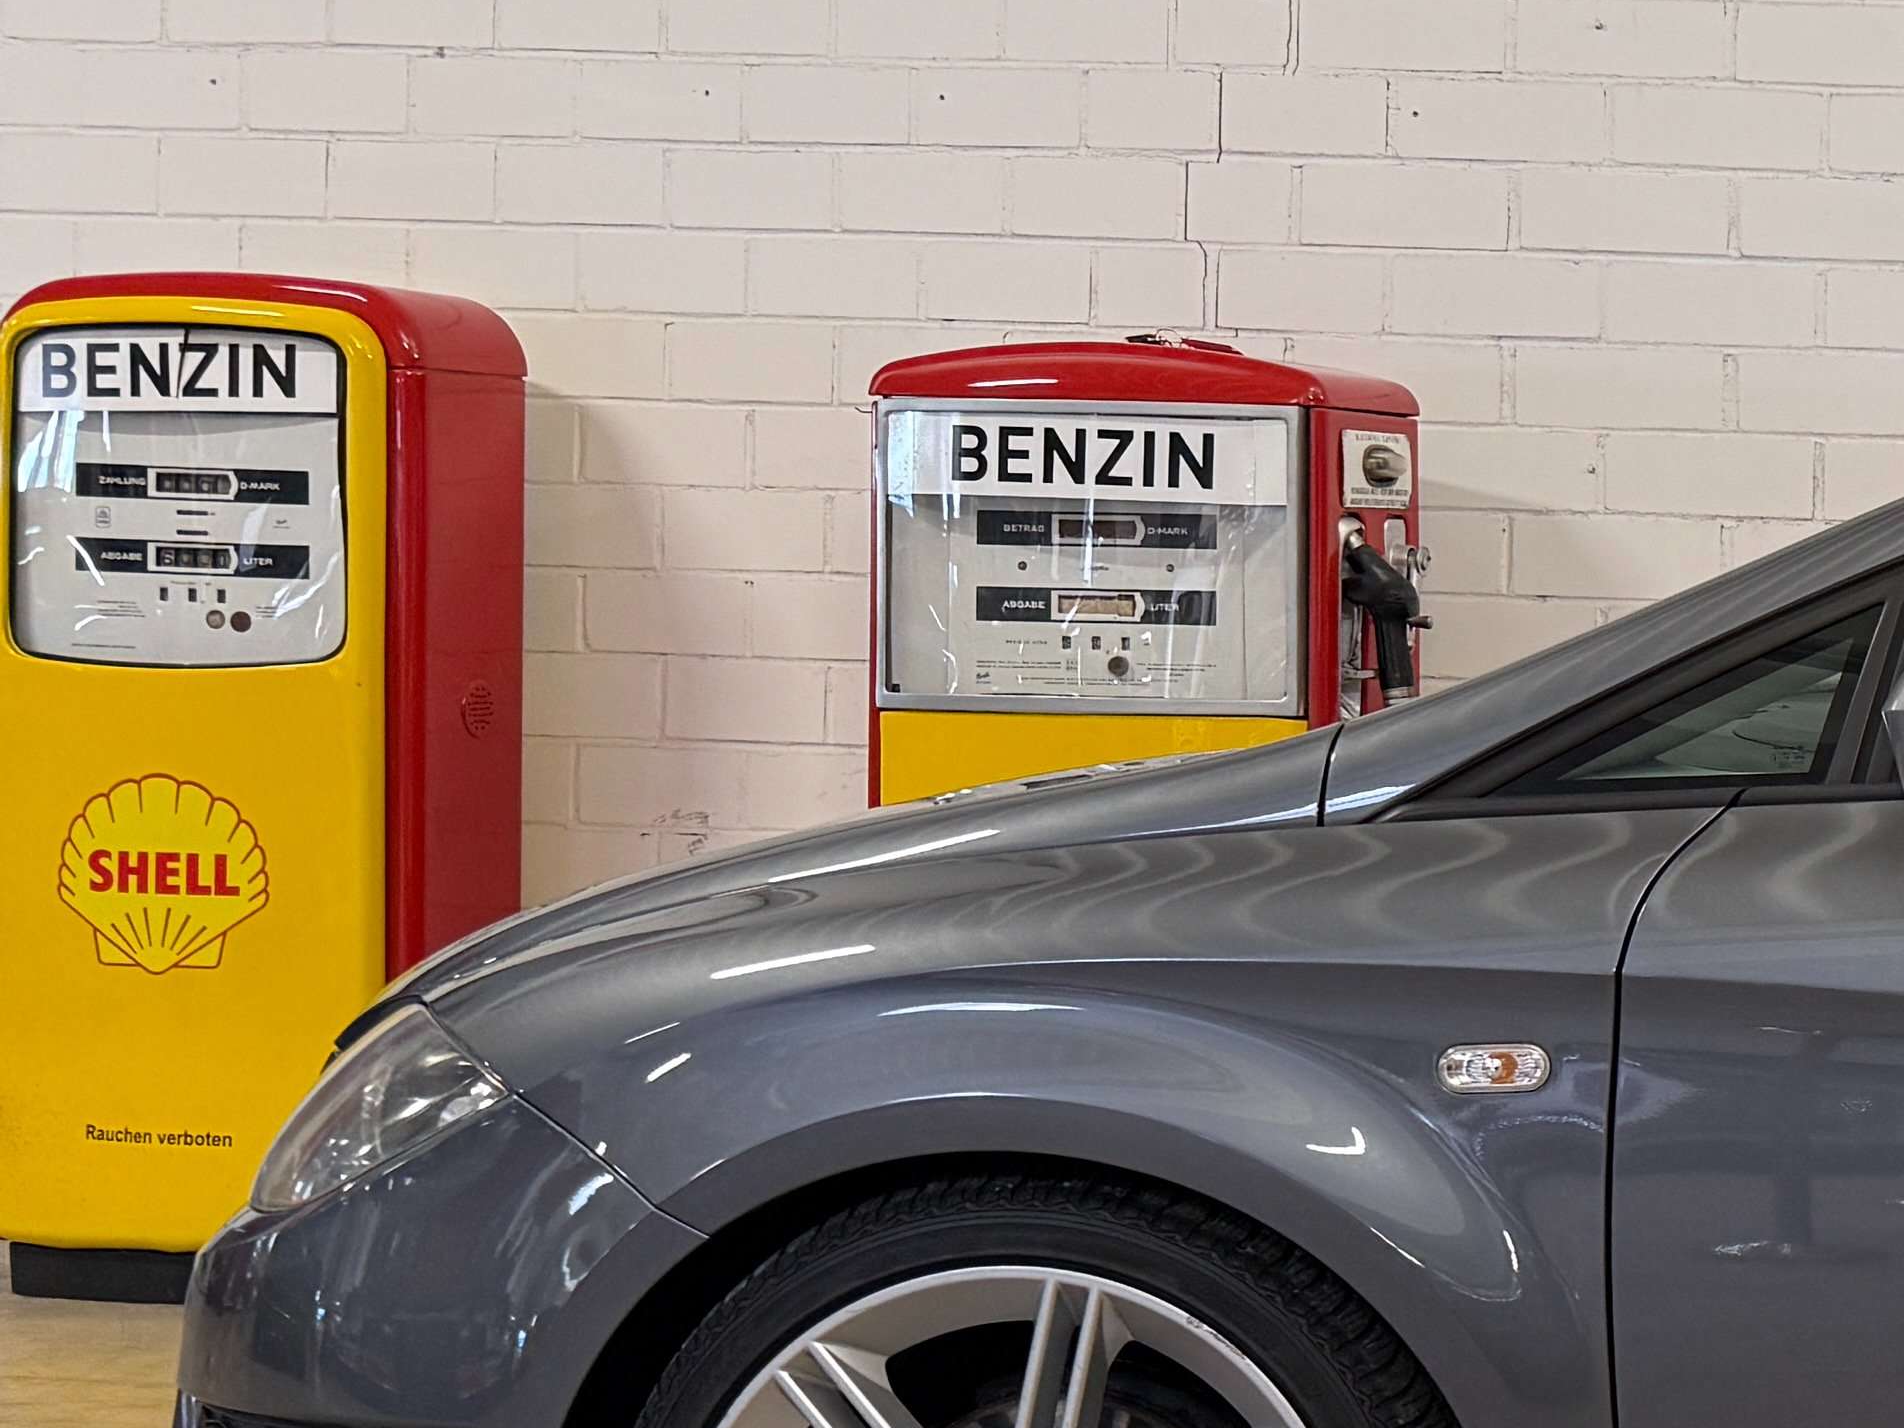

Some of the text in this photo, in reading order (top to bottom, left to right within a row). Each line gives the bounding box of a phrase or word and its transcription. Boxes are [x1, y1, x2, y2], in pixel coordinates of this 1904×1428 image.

[42, 343, 296, 398] BENZIN
[951, 425, 1215, 489] BENZIN
[243, 557, 274, 567] LITER
[88, 849, 241, 897] SHELL
[85, 1124, 232, 1147] Rauchen verboten
